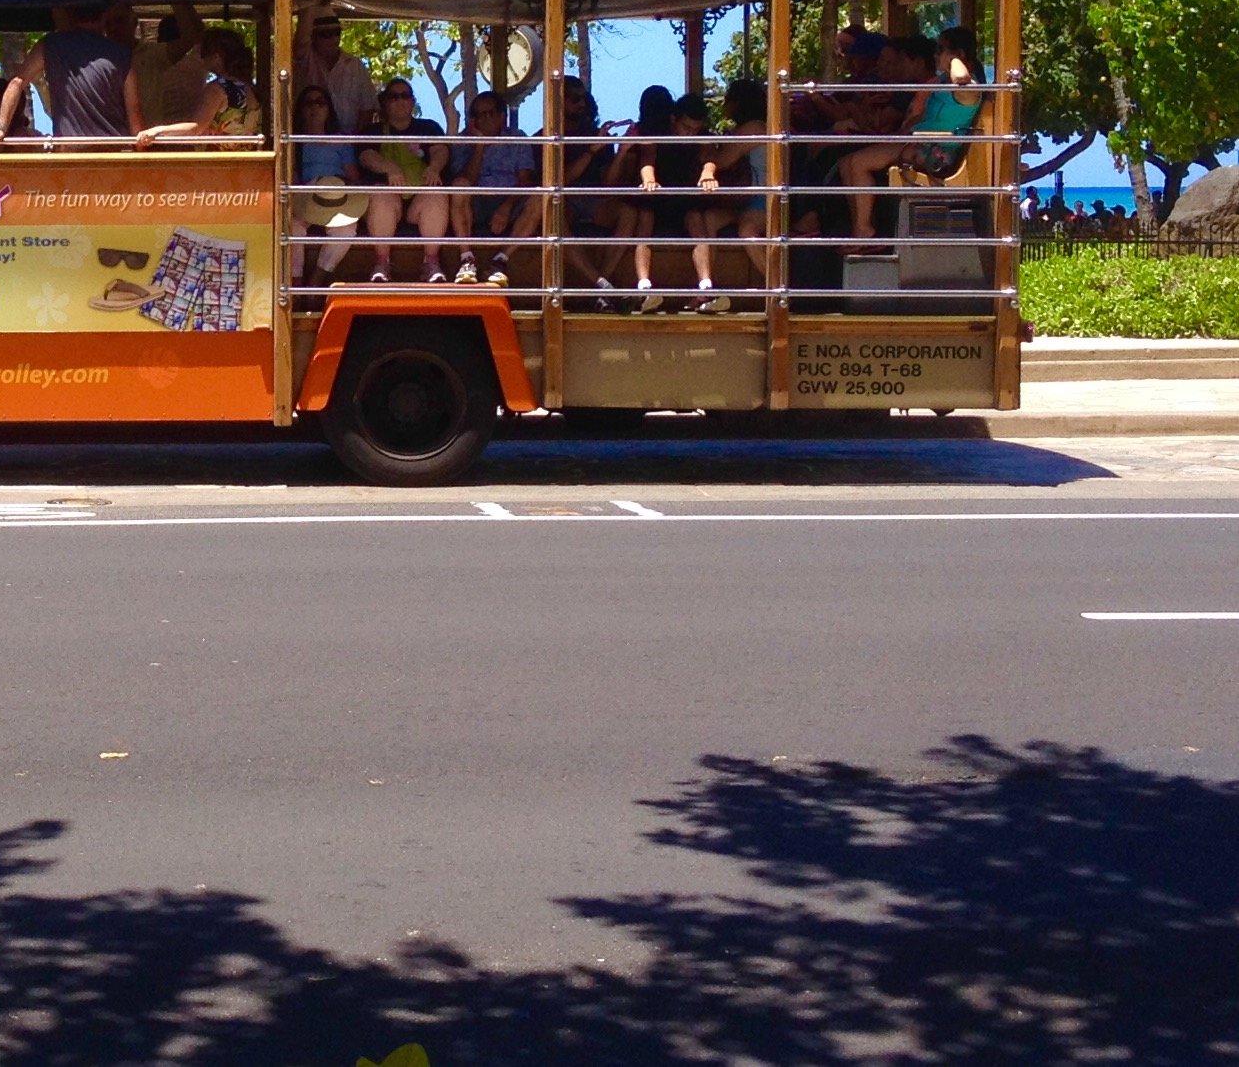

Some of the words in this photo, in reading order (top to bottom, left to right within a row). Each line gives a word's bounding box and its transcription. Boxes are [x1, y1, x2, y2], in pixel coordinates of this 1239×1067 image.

[25, 190, 56, 207] The
[60, 189, 89, 207] fun
[94, 193, 131, 211] way
[136, 192, 155, 207] to
[159, 193, 186, 207] see
[191, 189, 260, 207] Hawaii!
[22, 236, 70, 247] Store
[797, 344, 808, 358] E
[816, 345, 851, 358] NOA
[860, 344, 982, 359] CORPORATION
[797, 363, 831, 376] PUC
[839, 363, 872, 377] 894
[880, 363, 922, 377] T-68
[797, 380, 838, 394] GVW
[845, 381, 905, 396] 25,900
